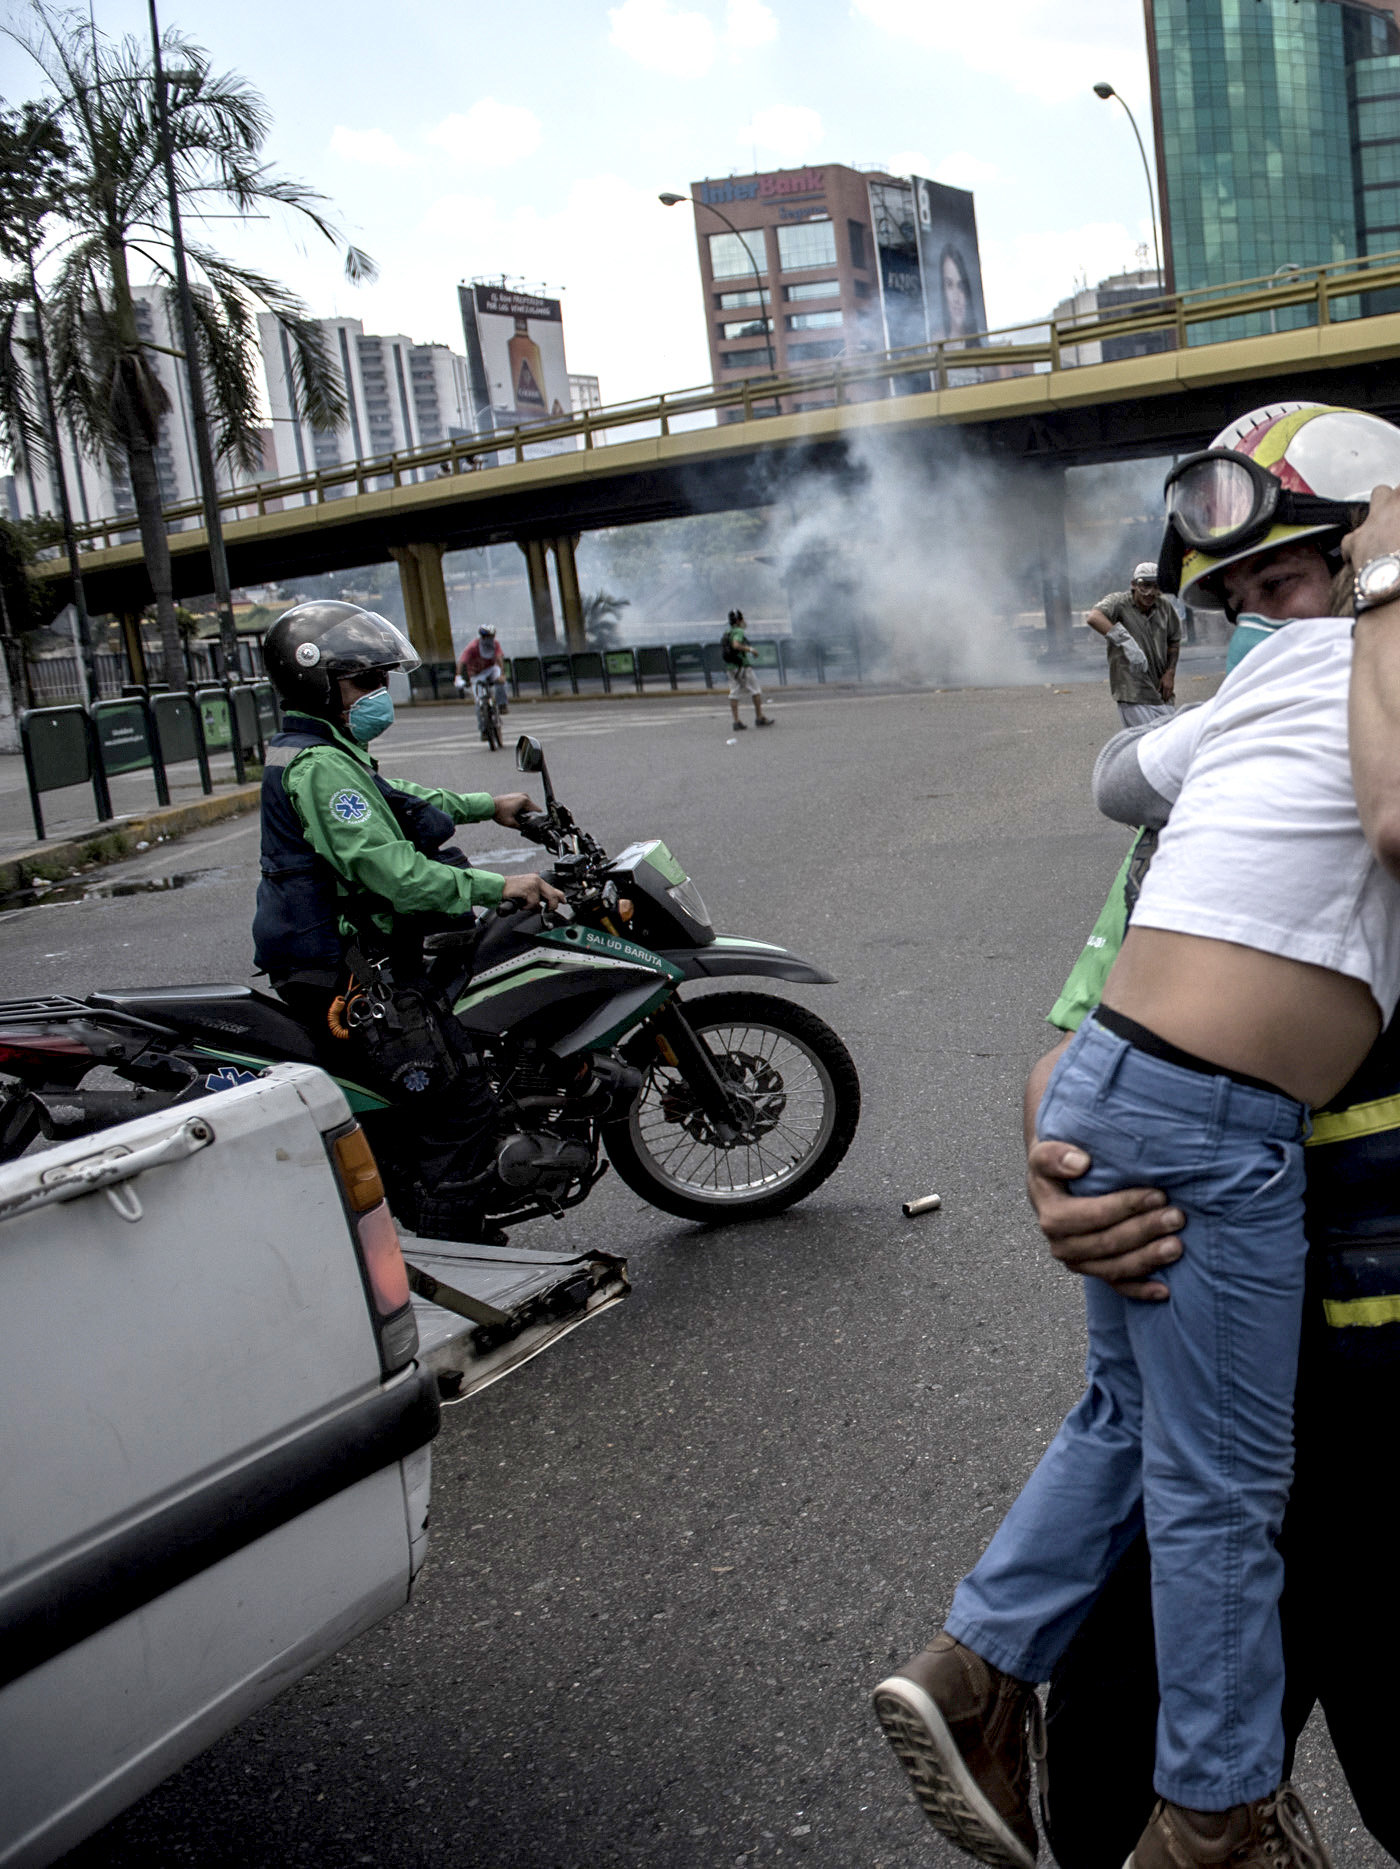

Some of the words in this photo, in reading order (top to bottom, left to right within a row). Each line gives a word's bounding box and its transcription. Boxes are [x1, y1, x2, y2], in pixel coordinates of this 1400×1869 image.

[702, 168, 824, 205] InterBank
[586, 933, 622, 950] SALUD
[624, 945, 662, 968] BARUTA
